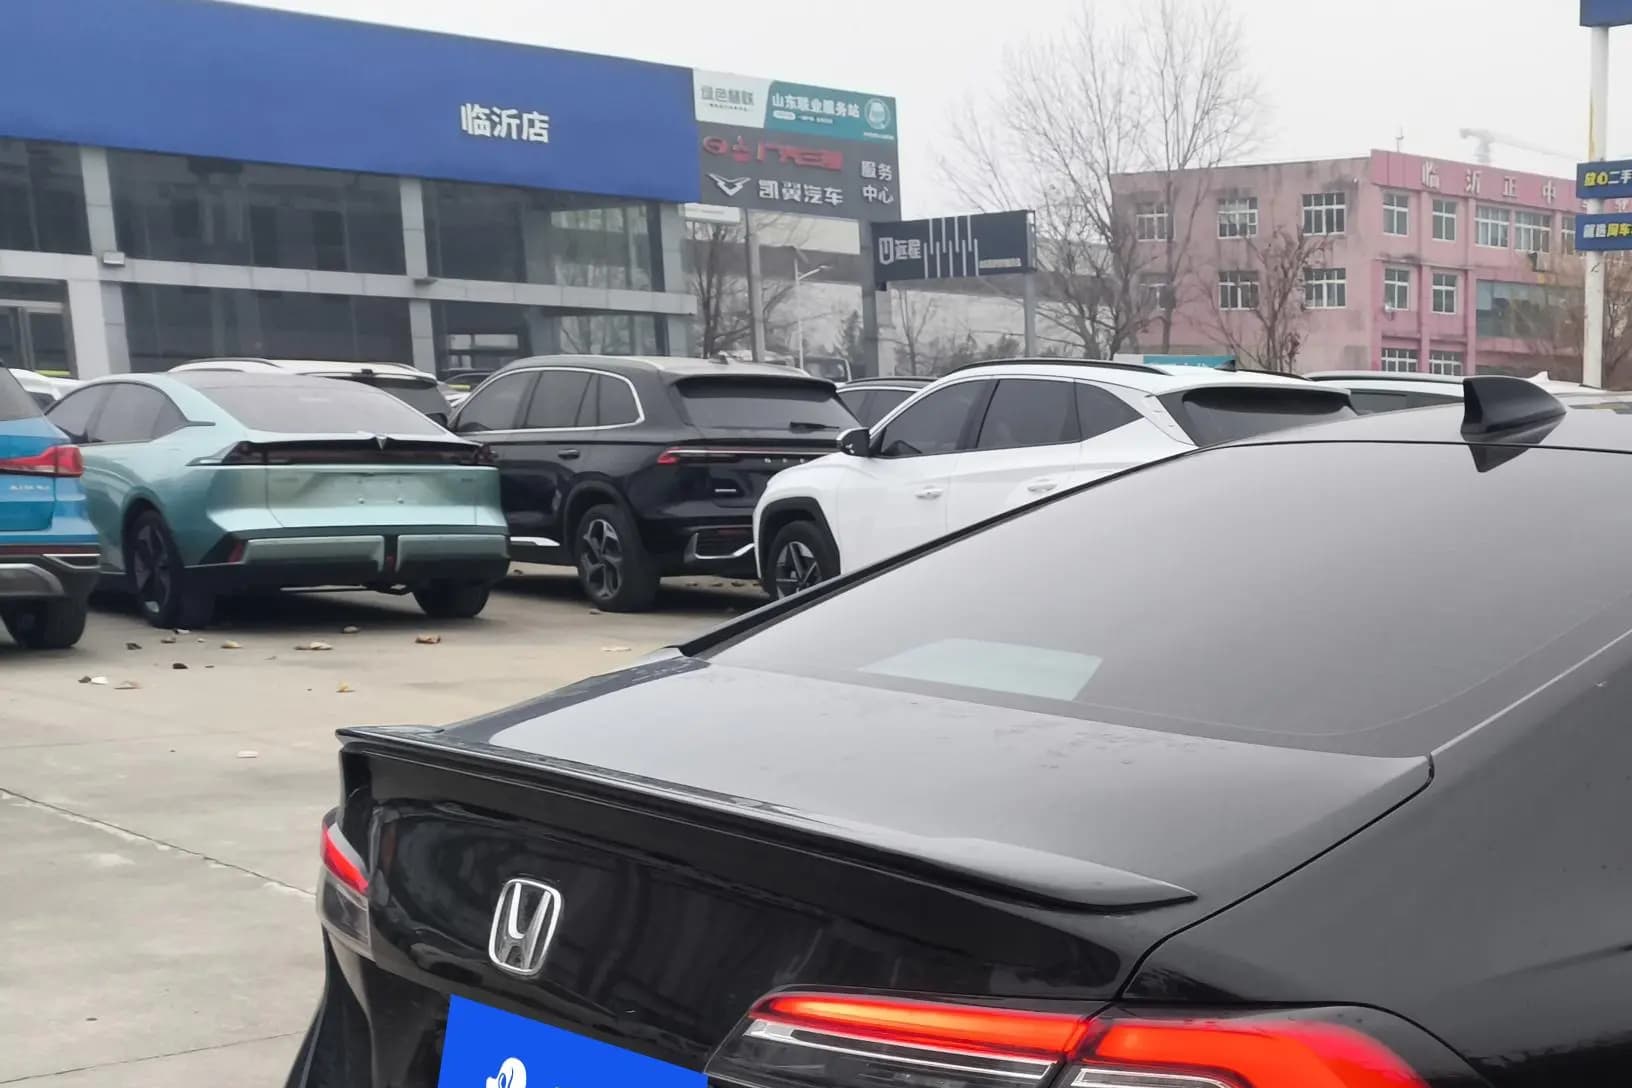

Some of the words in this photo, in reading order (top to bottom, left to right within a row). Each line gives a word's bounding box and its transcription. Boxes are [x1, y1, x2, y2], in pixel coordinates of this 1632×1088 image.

[461, 103, 549, 143] 临沂店
[861, 160, 893, 182] 服务
[758, 179, 843, 206] 凯翼汽车
[862, 184, 894, 204] 中心
